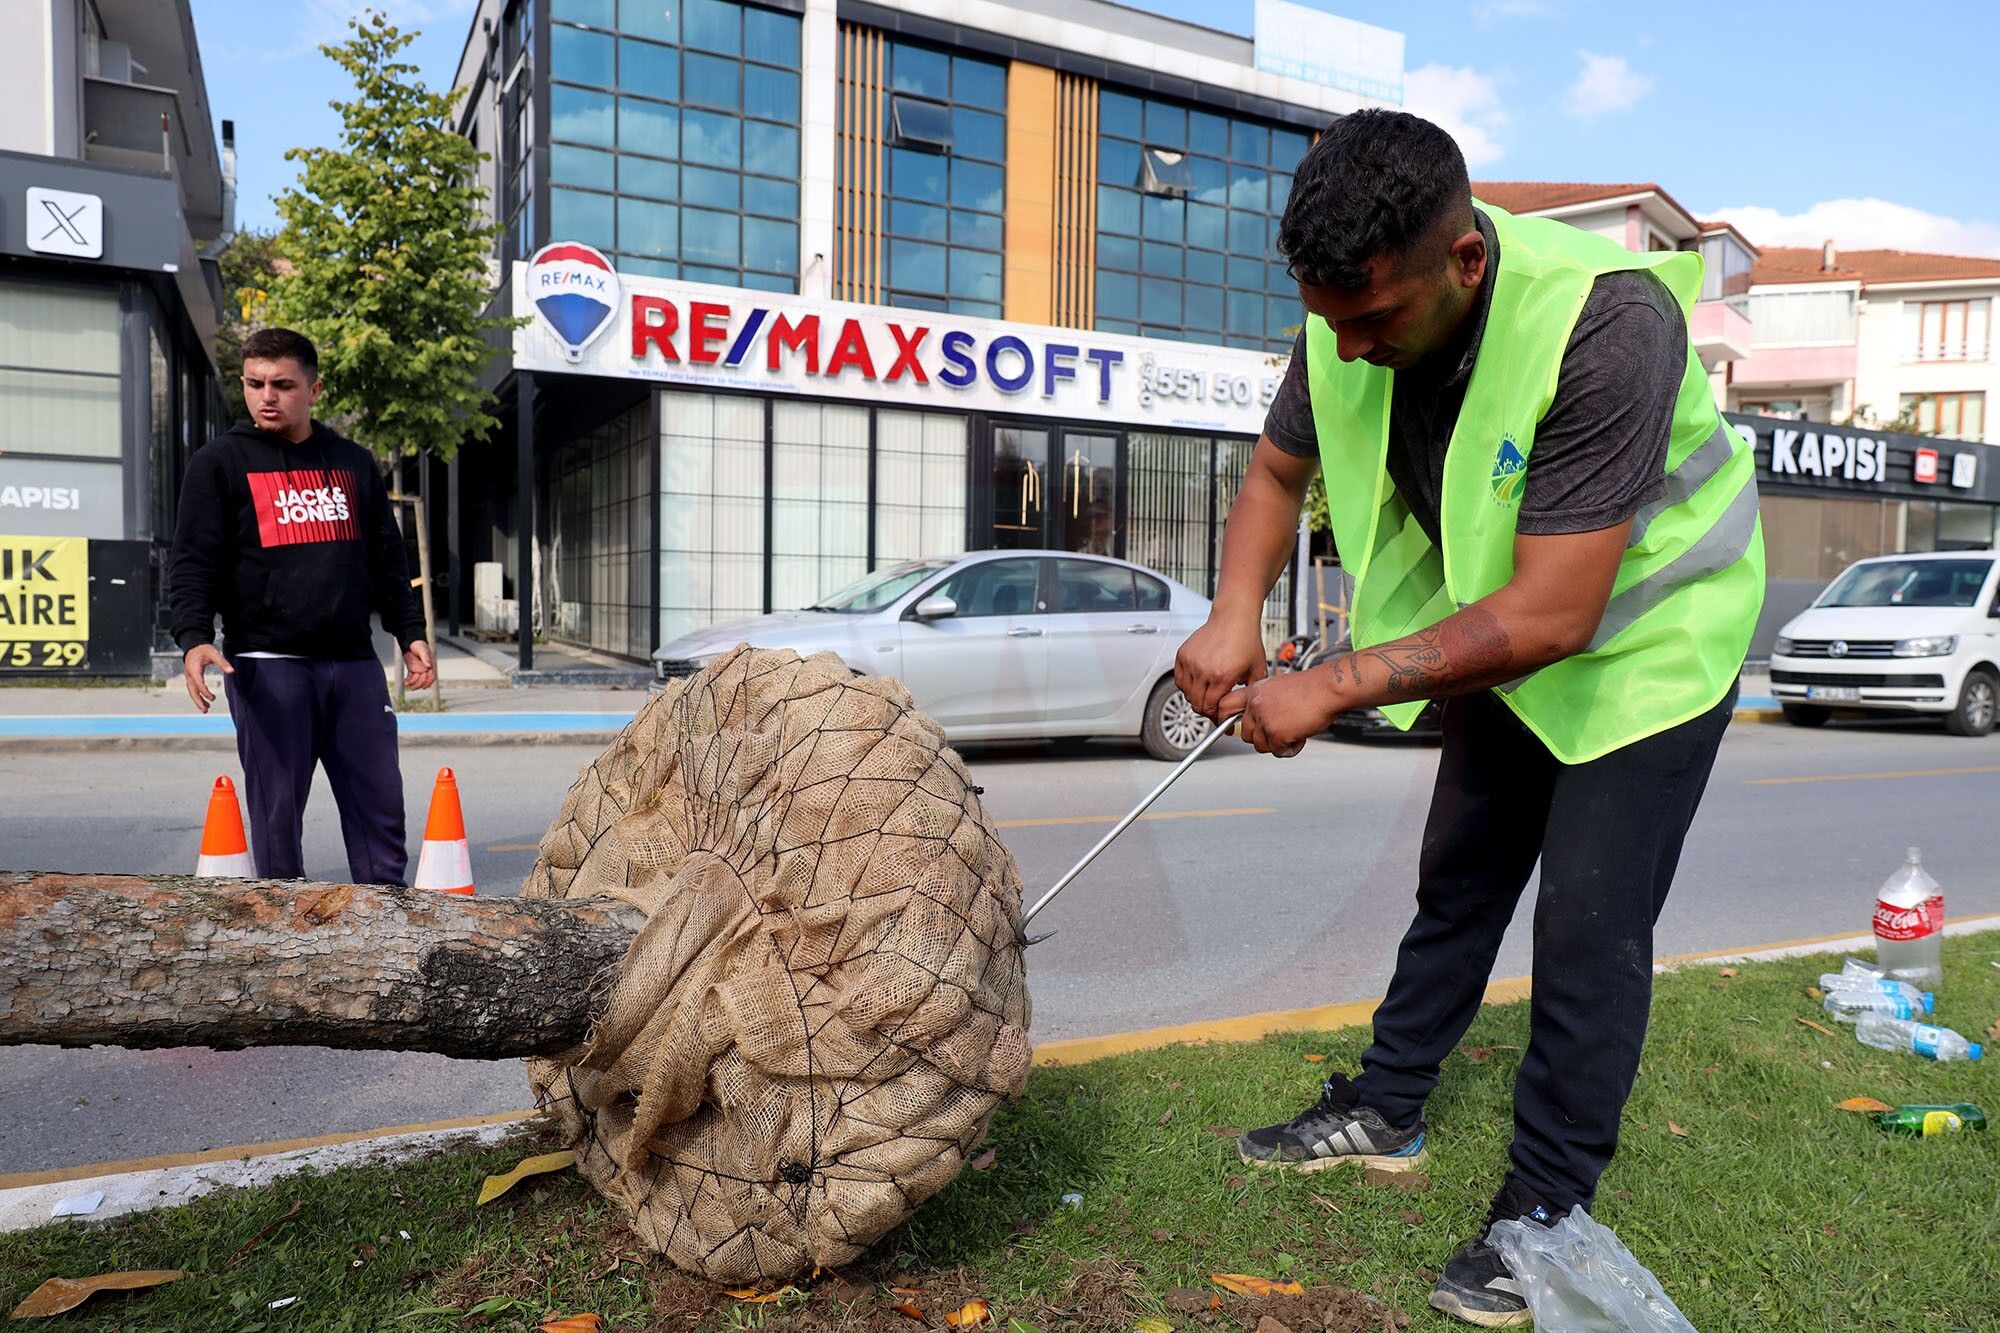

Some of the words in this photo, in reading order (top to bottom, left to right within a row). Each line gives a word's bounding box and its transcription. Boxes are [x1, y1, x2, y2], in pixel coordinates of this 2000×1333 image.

[541, 271, 606, 292] RE/MAX
[1157, 367, 1207, 401] 551
[1212, 373, 1252, 405] 50
[1259, 379, 1277, 407] 5
[1772, 428, 1887, 482] KAPISI
[0, 485, 80, 510] APISI
[277, 503, 349, 524] JONES
[3, 549, 58, 580] IK
[0, 585, 76, 625] AİRE
[42, 642, 85, 666] 29
